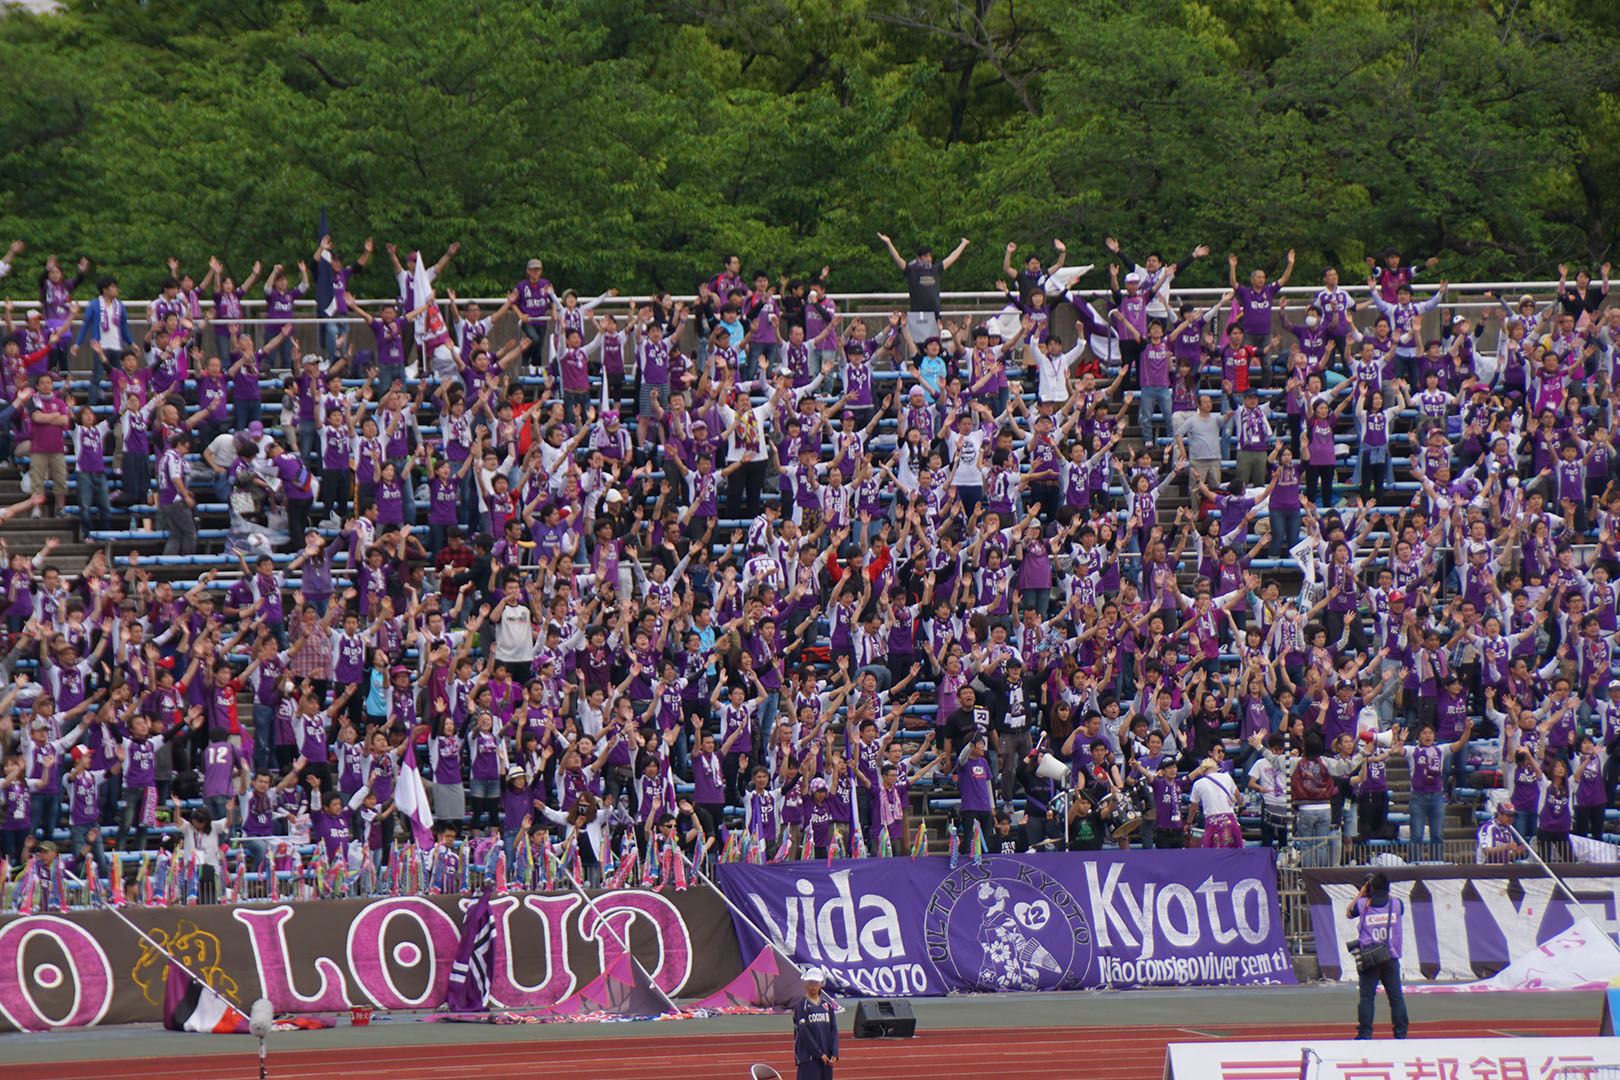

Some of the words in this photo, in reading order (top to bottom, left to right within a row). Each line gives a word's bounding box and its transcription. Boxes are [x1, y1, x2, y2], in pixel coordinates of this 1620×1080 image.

[208, 747, 228, 764] 12
[748, 868, 907, 963] vida
[926, 860, 992, 963] ULTRAS
[1016, 864, 1090, 945] KYOTO
[1022, 905, 1047, 926] 12
[1083, 861, 1271, 961] Kyoto
[232, 889, 693, 1014] LOUD
[848, 963, 928, 996] KYOTO
[1097, 955, 1135, 984] Não
[1199, 951, 1240, 981] viver
[1240, 953, 1271, 977] sem
